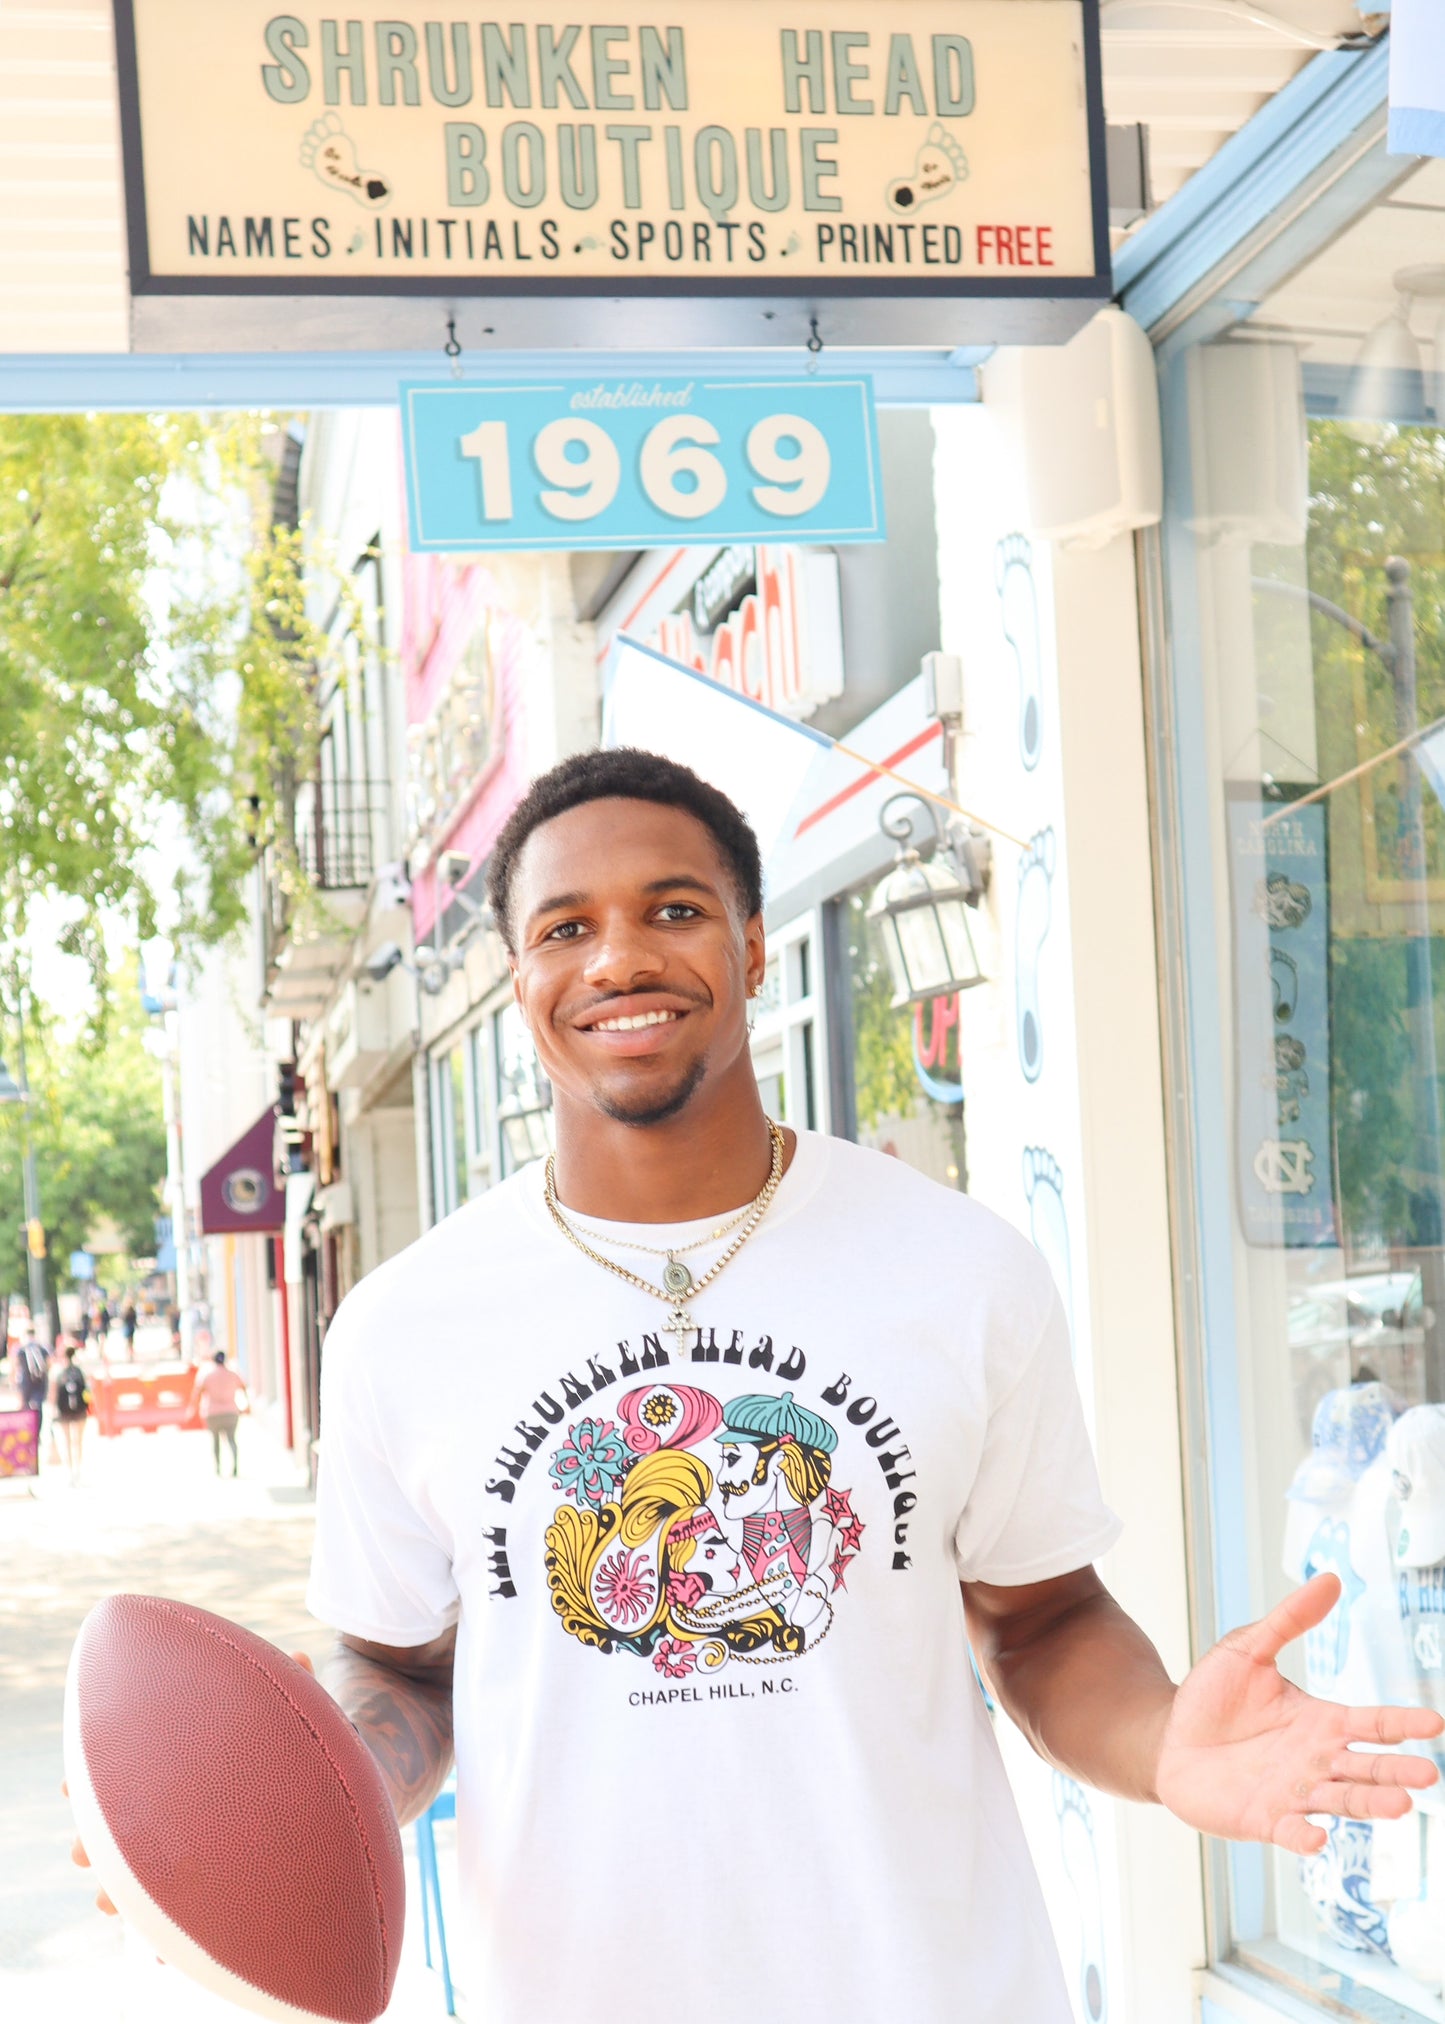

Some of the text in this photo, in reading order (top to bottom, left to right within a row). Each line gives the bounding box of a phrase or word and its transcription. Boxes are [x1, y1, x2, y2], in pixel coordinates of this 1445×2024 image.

[261, 15, 976, 117] SHRUNKEN HEAD
[445, 122, 843, 221] BOUTIQUE
[187, 215, 1055, 266] NAMES INITIALS SPORTS PRINTED FREE
[570, 382, 694, 410] established
[460, 414, 832, 521] 1969
[628, 1678, 799, 1706] CHAPEL HILL, N.C.
